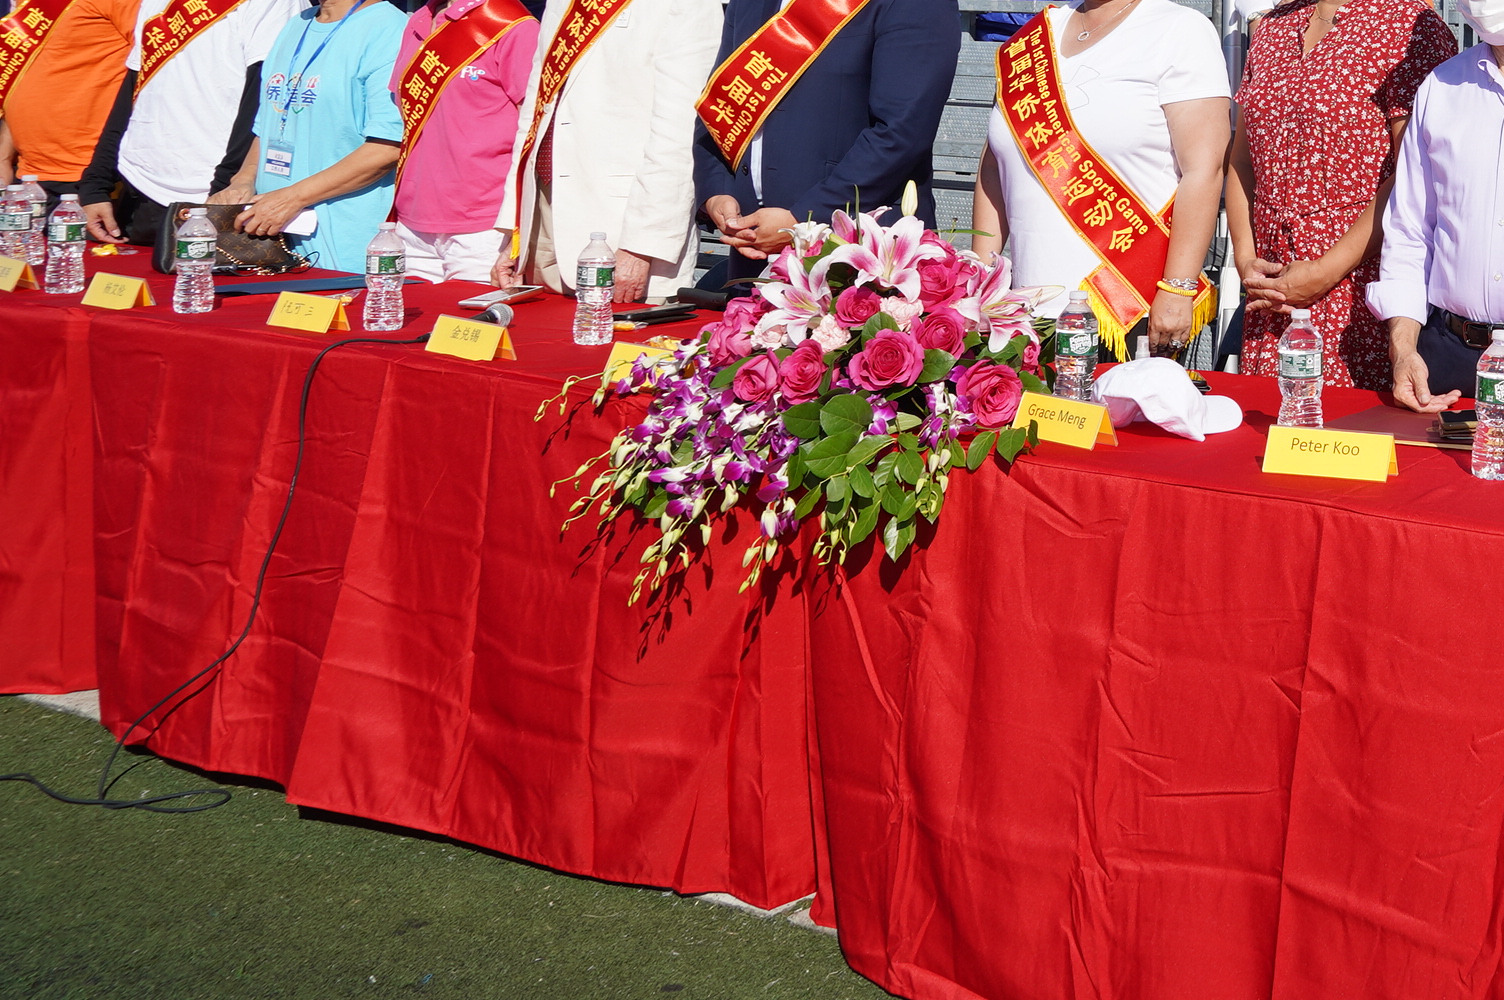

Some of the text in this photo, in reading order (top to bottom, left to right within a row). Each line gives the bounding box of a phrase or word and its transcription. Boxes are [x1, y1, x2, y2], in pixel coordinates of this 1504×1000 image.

[192, 9, 217, 25] The
[558, 14, 601, 71] American
[430, 63, 450, 84] The
[722, 67, 788, 152] The 1st Chinese
[1030, 25, 1149, 235] The 1st Chinese American Sports Game
[1004, 35, 1135, 253] 首届华侨体育运动会
[1028, 403, 1087, 430] Grace Meng
[1290, 437, 1361, 456] Peter Koo
